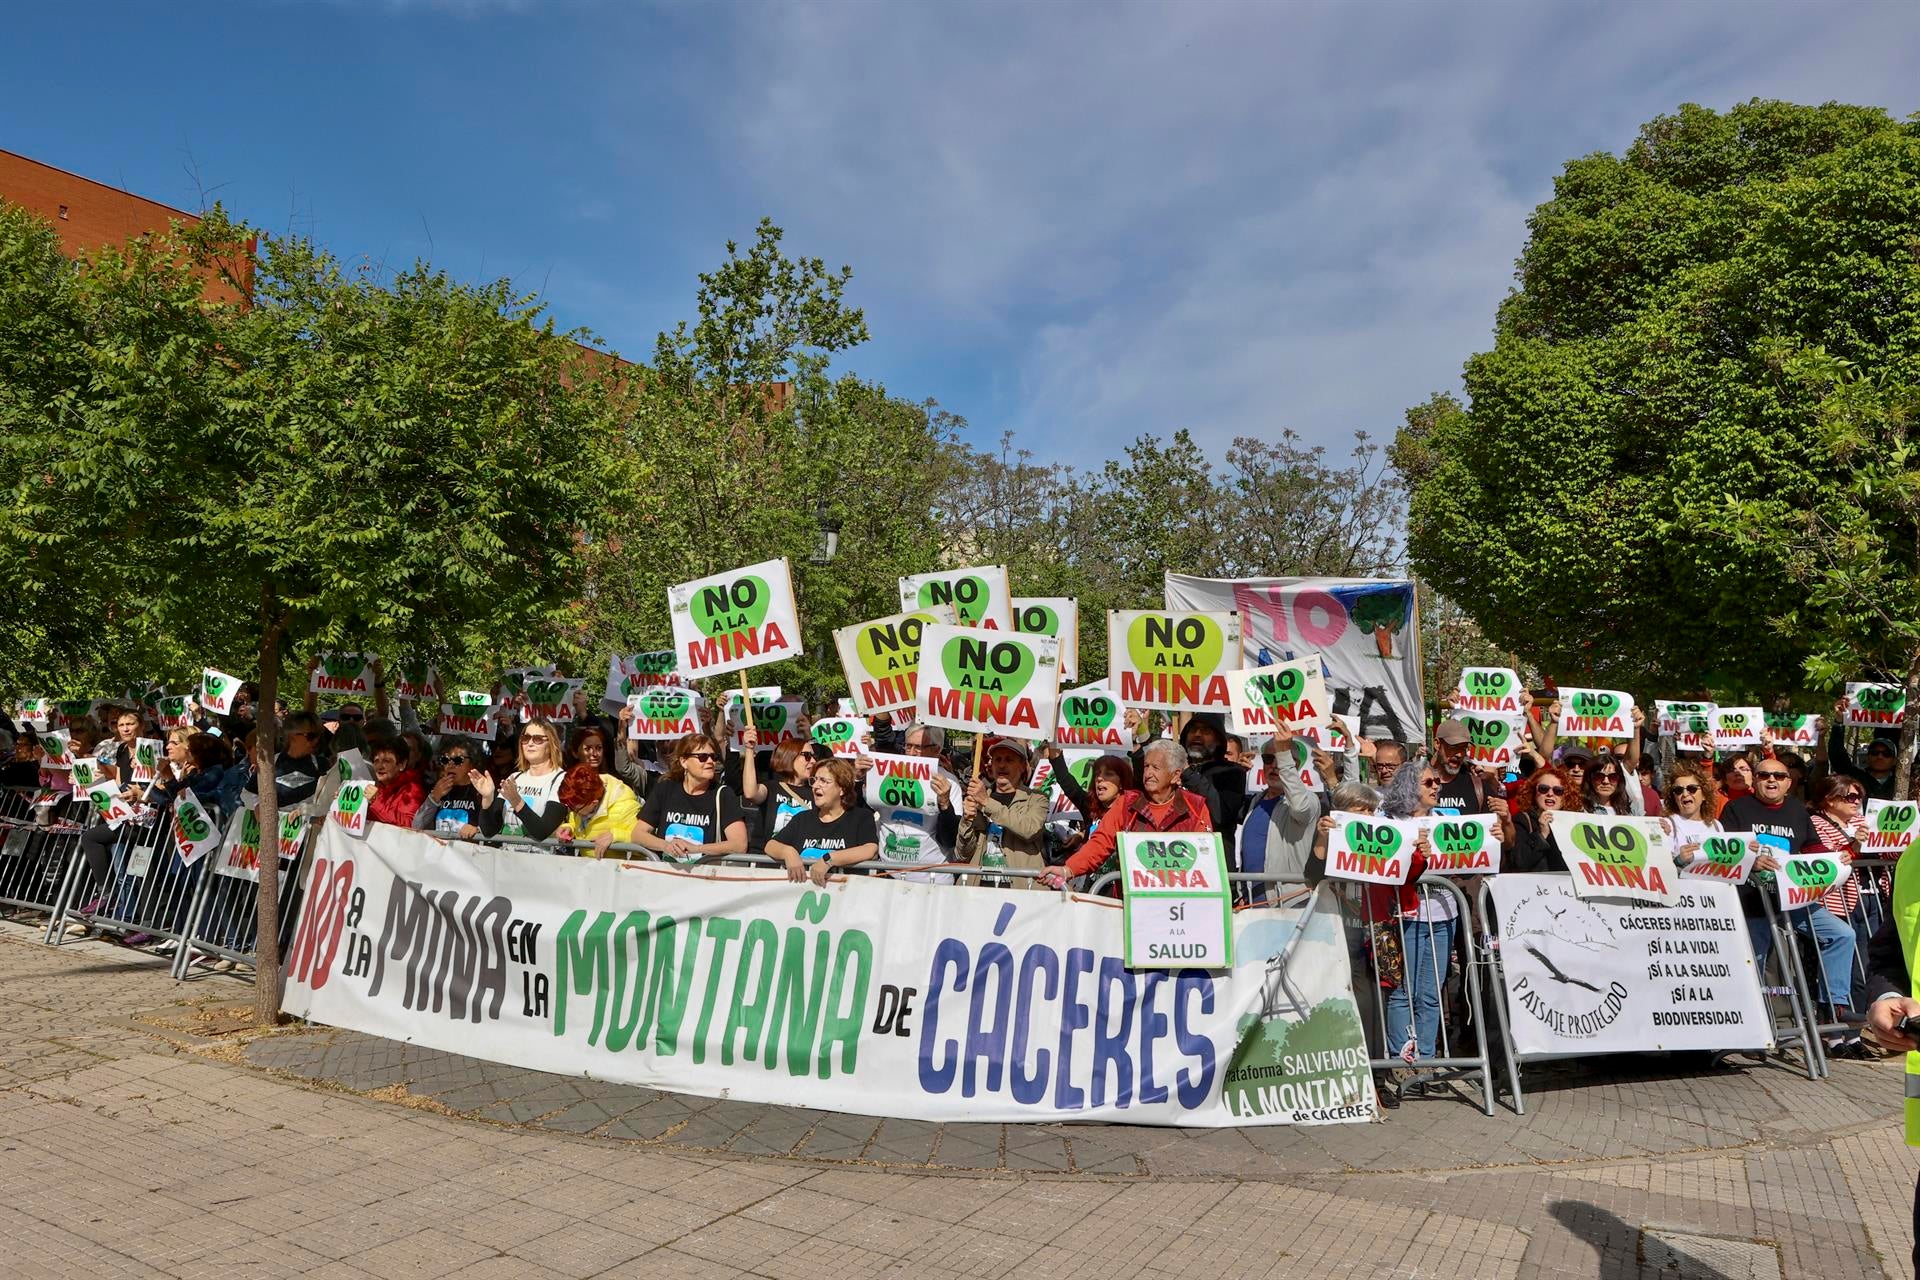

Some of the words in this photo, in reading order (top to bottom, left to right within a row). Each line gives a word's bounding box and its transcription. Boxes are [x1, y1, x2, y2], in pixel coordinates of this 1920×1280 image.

[703, 578, 758, 617] NO
[930, 578, 978, 605] NO
[712, 620, 724, 633] A
[727, 613, 748, 629] LA
[1232, 583, 1348, 647] NO
[868, 618, 922, 656] NO
[1145, 617, 1205, 649] NO
[688, 622, 790, 669] MINA
[643, 653, 672, 664] NO
[888, 657, 899, 670] A
[958, 639, 1021, 674] NO
[1154, 652, 1167, 667] A
[1173, 653, 1195, 668] LA
[205, 674, 221, 689] NO
[318, 676, 366, 691] MINA
[536, 682, 561, 693] NO
[630, 673, 680, 687] MINA
[959, 674, 973, 688] A
[979, 677, 1003, 692] LA
[1257, 670, 1296, 693] NO
[1473, 672, 1505, 687] NO
[860, 671, 917, 709] MI
[1121, 671, 1230, 706] MINA
[1866, 688, 1898, 702] NO
[650, 697, 682, 708] NO
[1072, 697, 1108, 716] NO
[1274, 694, 1288, 703] LA
[1460, 696, 1517, 711] MINA
[1581, 692, 1613, 708] NO
[752, 705, 780, 720] NO
[928, 687, 1040, 729] MINA
[1591, 708, 1604, 716] LA
[161, 716, 188, 727] MINA
[446, 715, 488, 734] MINA
[637, 719, 696, 734] MINA
[1074, 718, 1082, 726] A
[1086, 718, 1099, 726] LA
[1566, 716, 1625, 732] MINA
[1724, 714, 1744, 723] NO
[817, 722, 847, 736] NO
[1468, 719, 1503, 736] NO
[1716, 729, 1753, 738] MINA
[1057, 727, 1123, 746] MINA
[1478, 738, 1492, 746] LA
[140, 744, 151, 757] NO
[1468, 745, 1510, 763] INA
[76, 763, 89, 777] NO
[875, 759, 930, 780] MINA
[524, 786, 542, 796] MINA
[893, 779, 904, 787] LA
[908, 780, 915, 788] A
[343, 786, 360, 802] NO
[776, 793, 787, 803] NO
[886, 789, 916, 808] NO
[453, 800, 475, 810] MINA
[1440, 798, 1466, 808] MINA
[184, 806, 208, 833] NO
[333, 811, 361, 830] MINA
[666, 812, 680, 823] NO
[686, 814, 710, 826] MINA
[1885, 806, 1912, 822] NO
[1356, 822, 1394, 845] NO
[1443, 822, 1478, 841] NO
[1582, 824, 1636, 852] NO
[1752, 824, 1766, 833] NO
[1770, 825, 1795, 838] MINA
[803, 838, 816, 848] NO
[820, 838, 846, 849] MINA
[1446, 843, 1453, 851] A
[1457, 842, 1471, 851] LA
[1712, 838, 1740, 854] NO
[1867, 832, 1911, 848] MINA
[1147, 840, 1189, 858] NO
[1357, 844, 1365, 852] A
[1369, 845, 1383, 855] LA
[1165, 860, 1180, 868] LA
[1336, 851, 1401, 878] MINA
[1428, 851, 1491, 870] MINA
[1599, 853, 1607, 863] A
[1613, 853, 1633, 864] LA
[1794, 859, 1830, 875] NO
[1133, 869, 1209, 888] MINA
[1578, 862, 1668, 895] MINA
[1690, 861, 1742, 880] MINA
[347, 887, 365, 928] A
[1506, 897, 1530, 937] Sierra
[1537, 884, 1550, 896] de
[1559, 886, 1574, 898] la
[1700, 896, 1716, 908] UN
[1169, 902, 1184, 921] SÍ
[287, 858, 354, 990] NO
[1620, 914, 1671, 931] CÁCERES
[1674, 918, 1736, 931] HABITABLE!
[368, 874, 512, 1025] MINA
[508, 918, 544, 966] EN
[1648, 937, 1662, 956] ¡SÍ
[1665, 942, 1672, 954] A
[1674, 942, 1689, 954] LA
[1690, 941, 1719, 954] VIDA!
[342, 933, 372, 978] LA
[1148, 944, 1207, 959] SALUD
[1648, 961, 1662, 980] ¡SÍ
[1666, 965, 1674, 978] A
[1674, 965, 1689, 978] LA
[1690, 964, 1731, 978] SALUD!
[553, 889, 874, 1080] MONTAÑA
[522, 969, 550, 1019] LA
[1671, 984, 1686, 1004] ¡SÍ
[1689, 988, 1697, 1001] A
[1700, 988, 1714, 1001] LA
[872, 984, 918, 1037] DE
[918, 902, 1216, 1110] CÁCERES
[1512, 977, 1565, 1032] PAISAJE
[1568, 981, 1628, 1035] PROTEGIDO
[1652, 1011, 1743, 1026] BIODIVERSIDAD!
[1284, 1046, 1369, 1076] SALVEMOS
[1224, 1088, 1256, 1118] LA
[1257, 1070, 1376, 1114] MONTAÑA
[1292, 1110, 1310, 1122] de
[1312, 1104, 1374, 1120] CÁCERES
